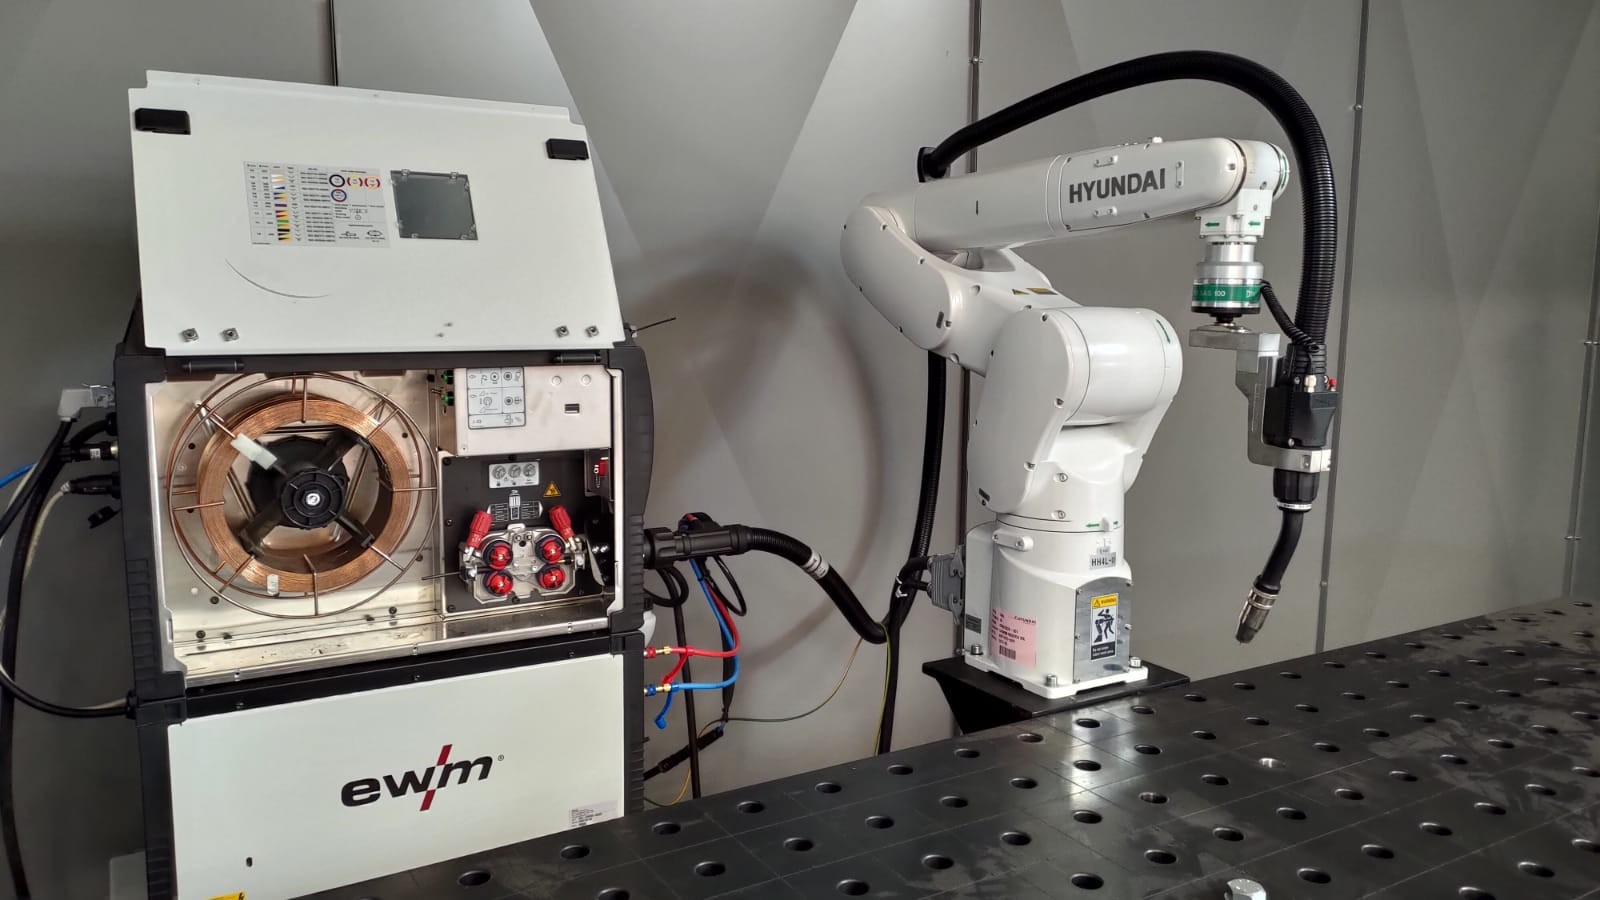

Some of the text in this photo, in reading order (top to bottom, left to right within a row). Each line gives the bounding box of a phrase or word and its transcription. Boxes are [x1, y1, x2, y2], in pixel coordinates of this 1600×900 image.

[1069, 167, 1166, 204] HYUNDAI
[1214, 289, 1226, 297] 100
[341, 747, 494, 808] ewm
